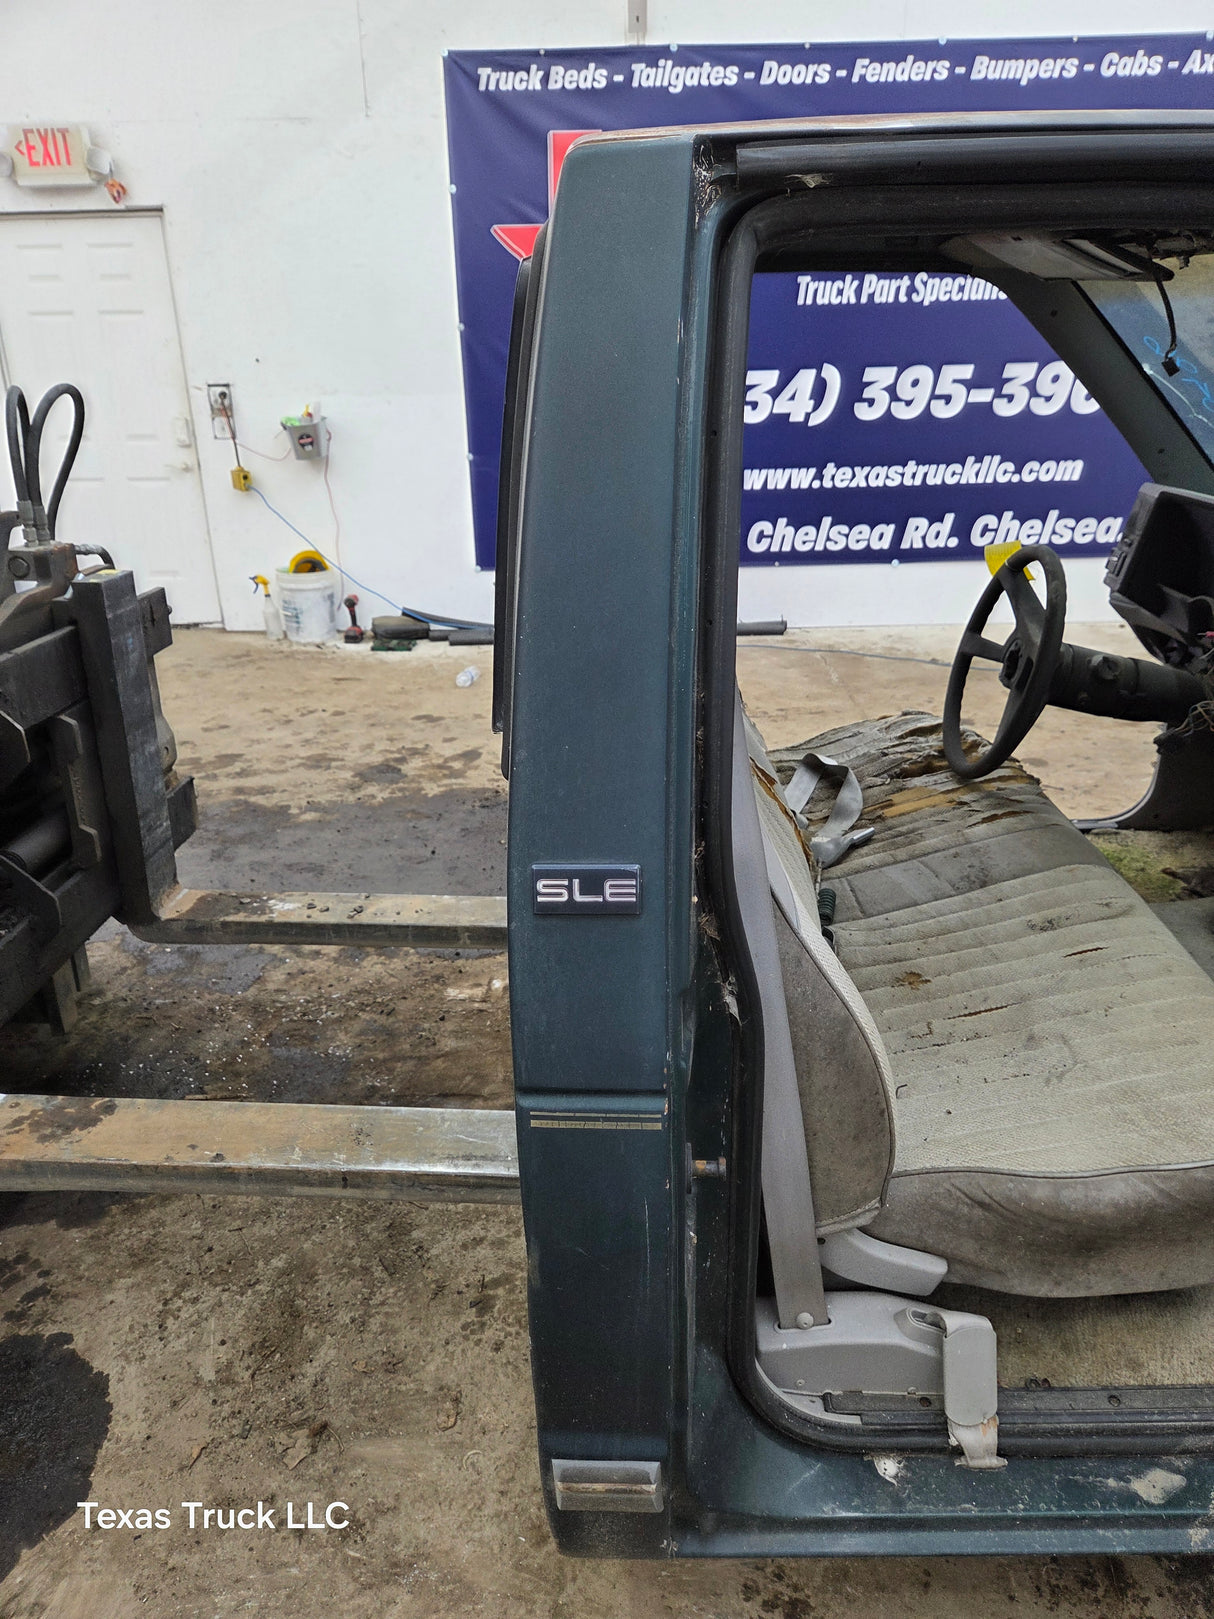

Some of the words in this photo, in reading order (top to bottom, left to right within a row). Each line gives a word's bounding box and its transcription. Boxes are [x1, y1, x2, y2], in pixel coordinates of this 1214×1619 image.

[477, 64, 545, 91] Truck
[547, 62, 608, 90] Beds
[631, 58, 739, 94] Tailgates
[759, 60, 832, 85] Doors
[851, 54, 951, 83] Fenders
[970, 55, 1078, 86] Bumpers
[1100, 49, 1163, 77] Cabs
[22, 127, 72, 167] EXIT
[797, 274, 860, 306] Truck
[860, 274, 911, 304] Part
[743, 455, 1084, 490] www.texastruckllc.com
[747, 516, 896, 553] Chelsea
[900, 512, 959, 549] Rd.
[536, 878, 637, 902] SLE
